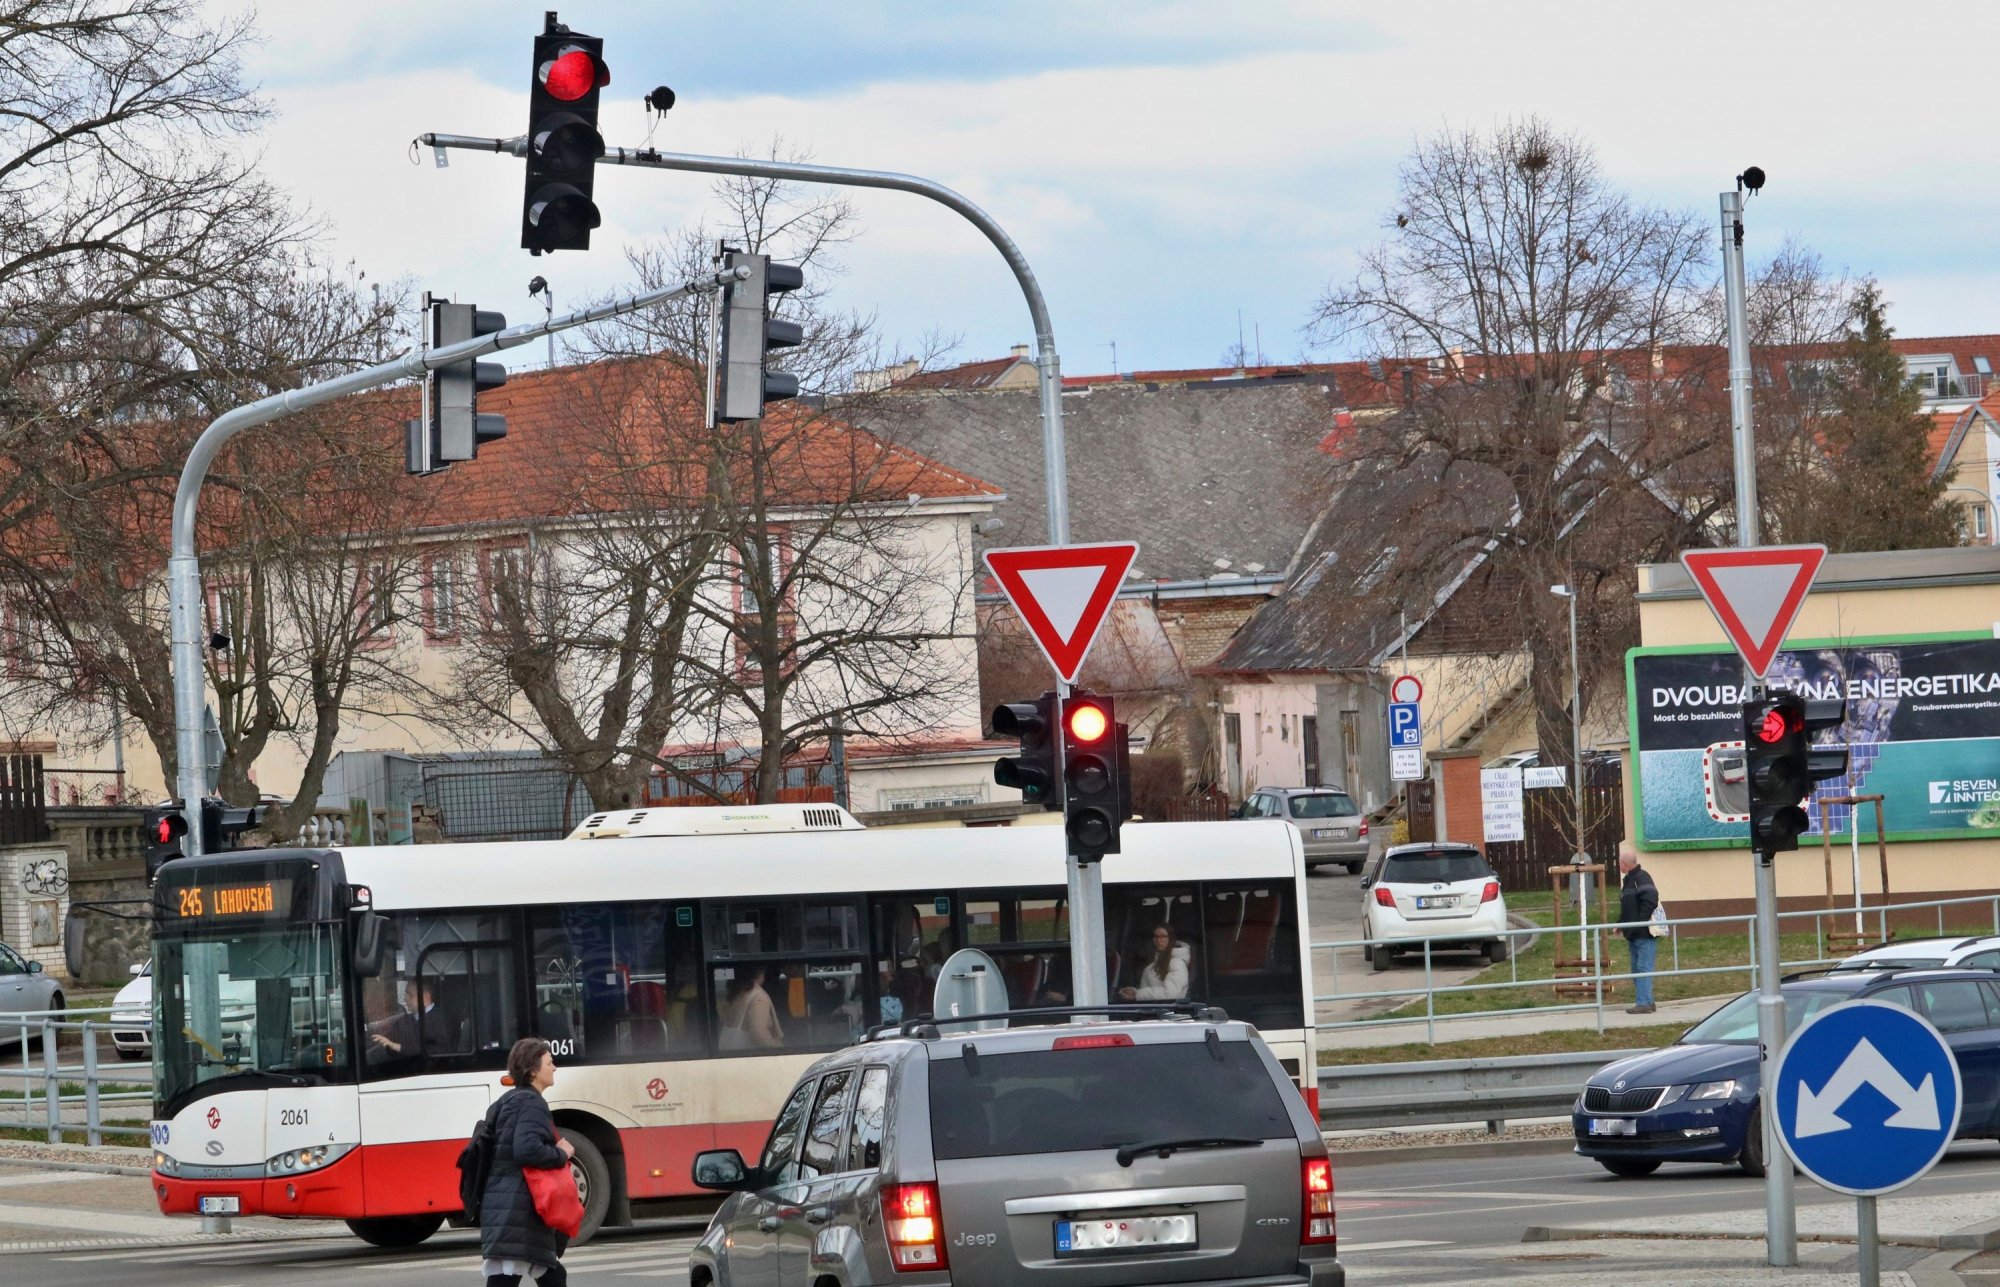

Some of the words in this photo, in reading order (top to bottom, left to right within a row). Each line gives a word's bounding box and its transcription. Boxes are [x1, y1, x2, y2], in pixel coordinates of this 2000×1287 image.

[1846, 673, 2000, 699] ENERGETIKA
[1395, 708, 1413, 733] P
[1653, 714, 1676, 722] Most
[1677, 713, 1689, 721] do
[1690, 711, 1742, 720] bezuhlíkové
[179, 888, 202, 917] 245
[213, 883, 273, 914] LAHOVSKÁ
[544, 1039, 574, 1055] 061
[326, 1048, 333, 1063] 2
[281, 1109, 309, 1126] 2061
[328, 1132, 335, 1142] 4
[954, 1232, 997, 1247] Jeep
